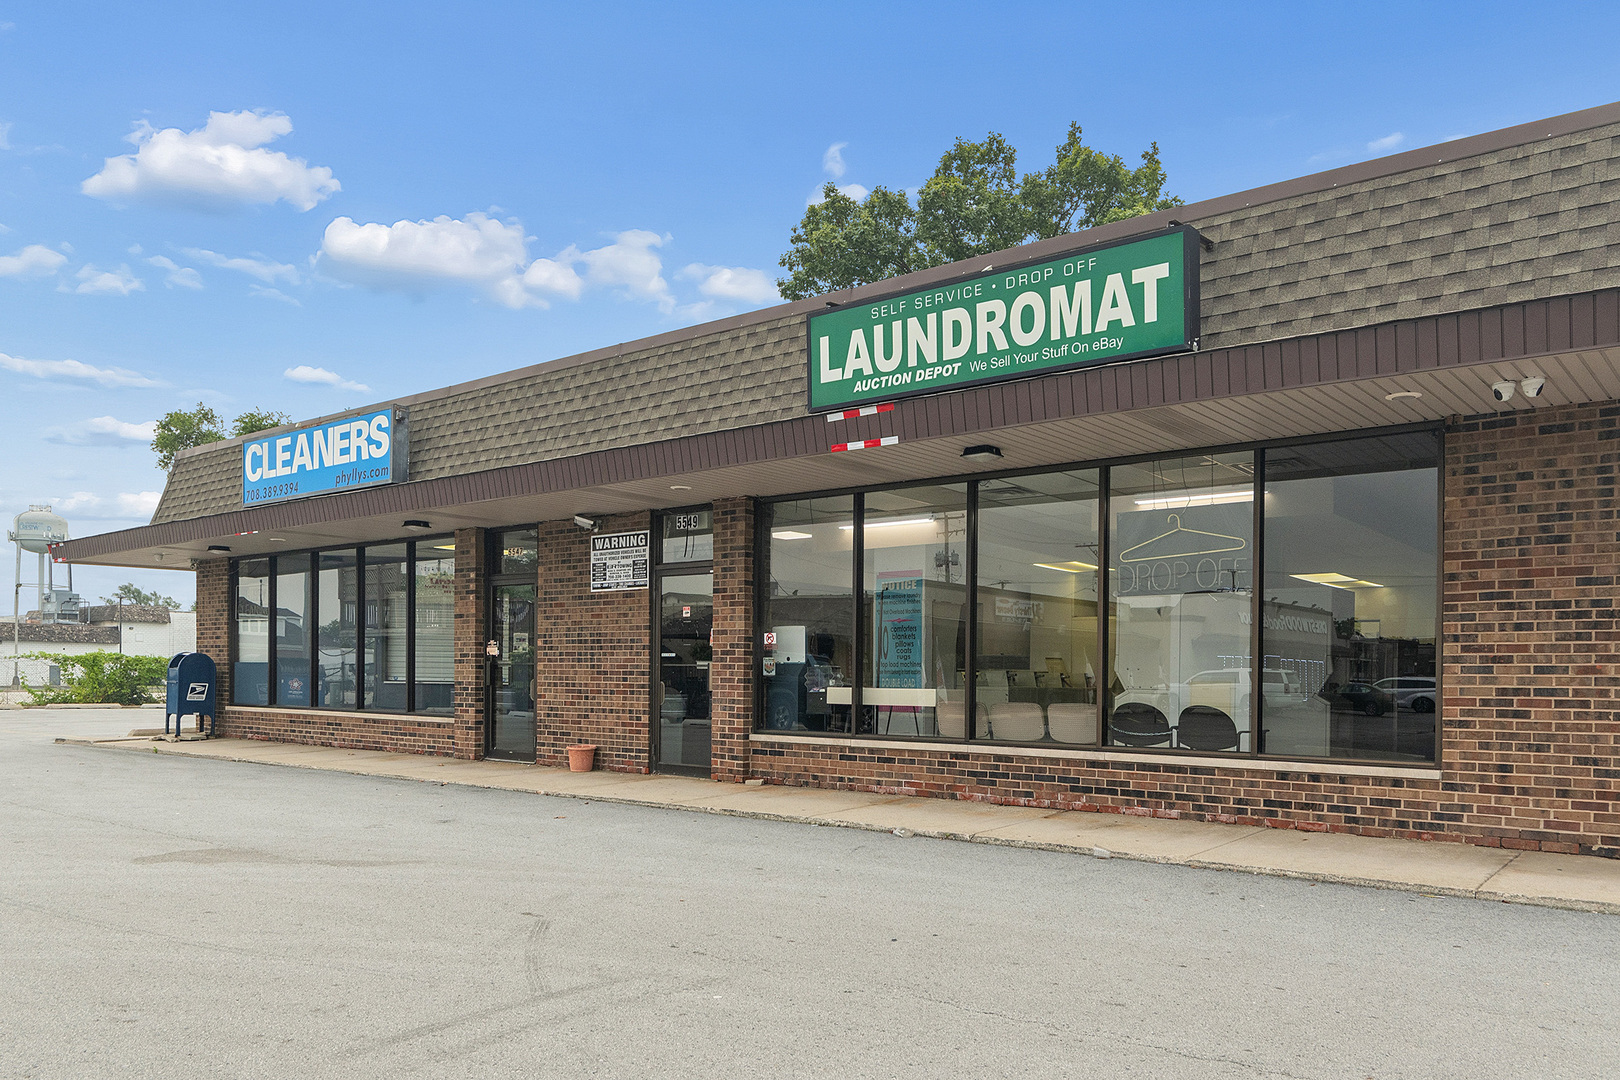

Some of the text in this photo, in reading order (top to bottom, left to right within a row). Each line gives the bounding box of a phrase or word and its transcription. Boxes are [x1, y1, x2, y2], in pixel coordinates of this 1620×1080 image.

[871, 257, 1097, 320] SELF SERVICE DROP OFF
[819, 262, 1170, 384] LAUNDROMAT
[969, 336, 1124, 373] We Sell Your Stuff On eBay
[853, 362, 962, 393] AUCTION DEPOT
[245, 414, 389, 482] CLEANERS
[335, 466, 389, 487] phyllys.com
[246, 482, 299, 501] 708.389.9394
[677, 515, 698, 529] 5549
[594, 534, 646, 550] WARNING
[881, 579, 917, 591] NOTICE
[1117, 557, 1247, 593] DROP OFF
[890, 624, 917, 633] comforters
[892, 632, 916, 640] blankets
[895, 641, 914, 649] pillows
